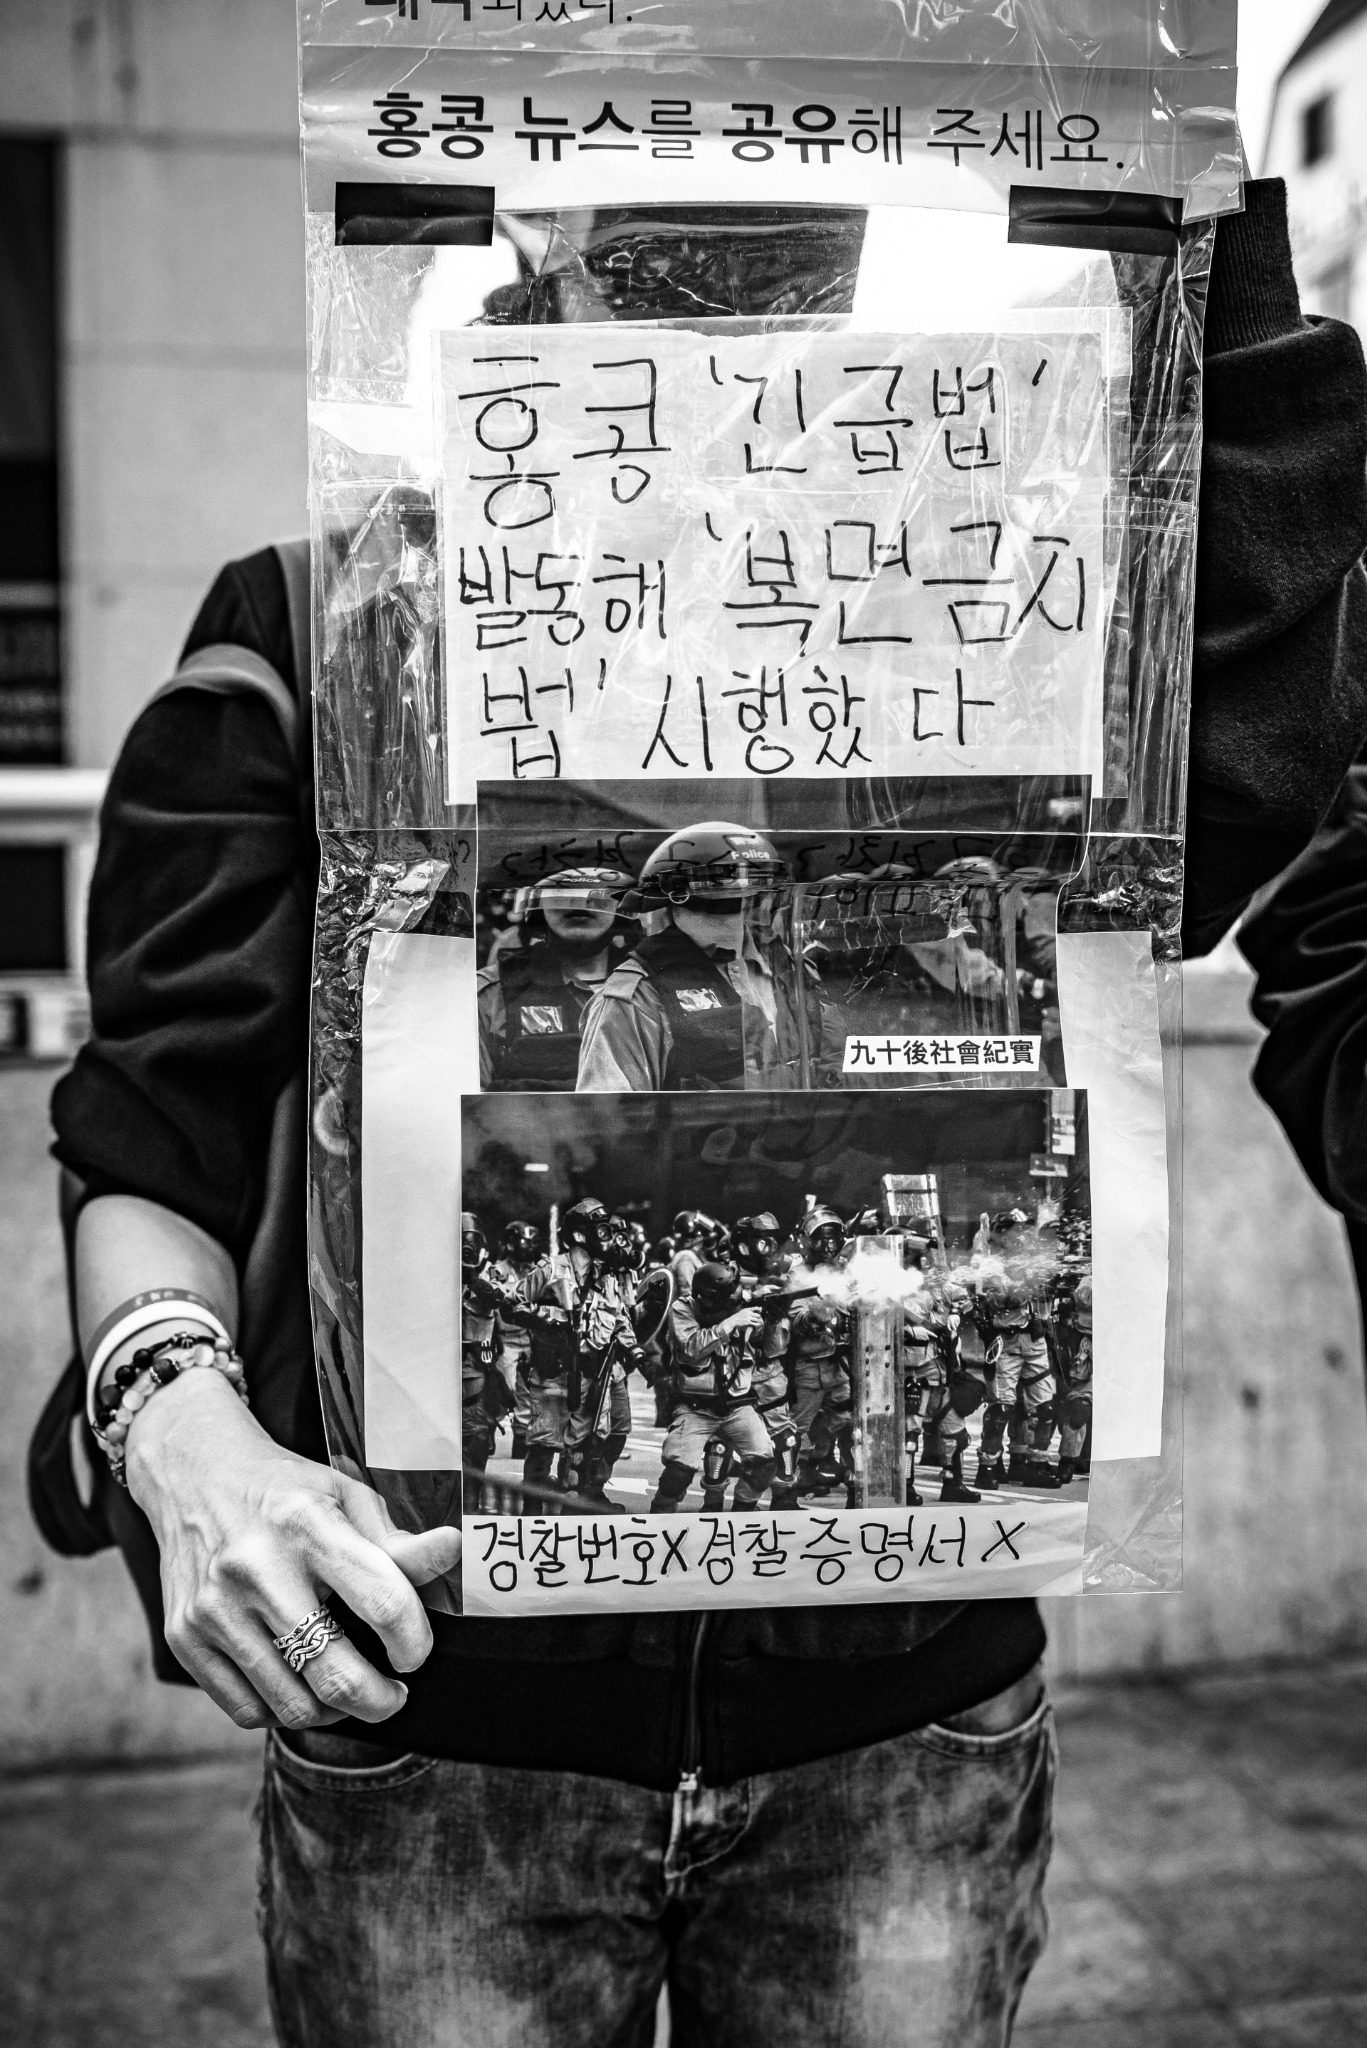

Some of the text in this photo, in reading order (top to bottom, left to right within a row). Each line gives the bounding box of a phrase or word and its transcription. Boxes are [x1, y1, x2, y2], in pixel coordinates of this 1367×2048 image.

[367, 92, 1125, 171] 홍콩 뉴스를 공유해 주세요.
[458, 355, 672, 530] 홍콩
[458, 544, 668, 652] 발동해
[731, 849, 771, 861] Police
[850, 1039, 1035, 1066] 九十後社會紀實
